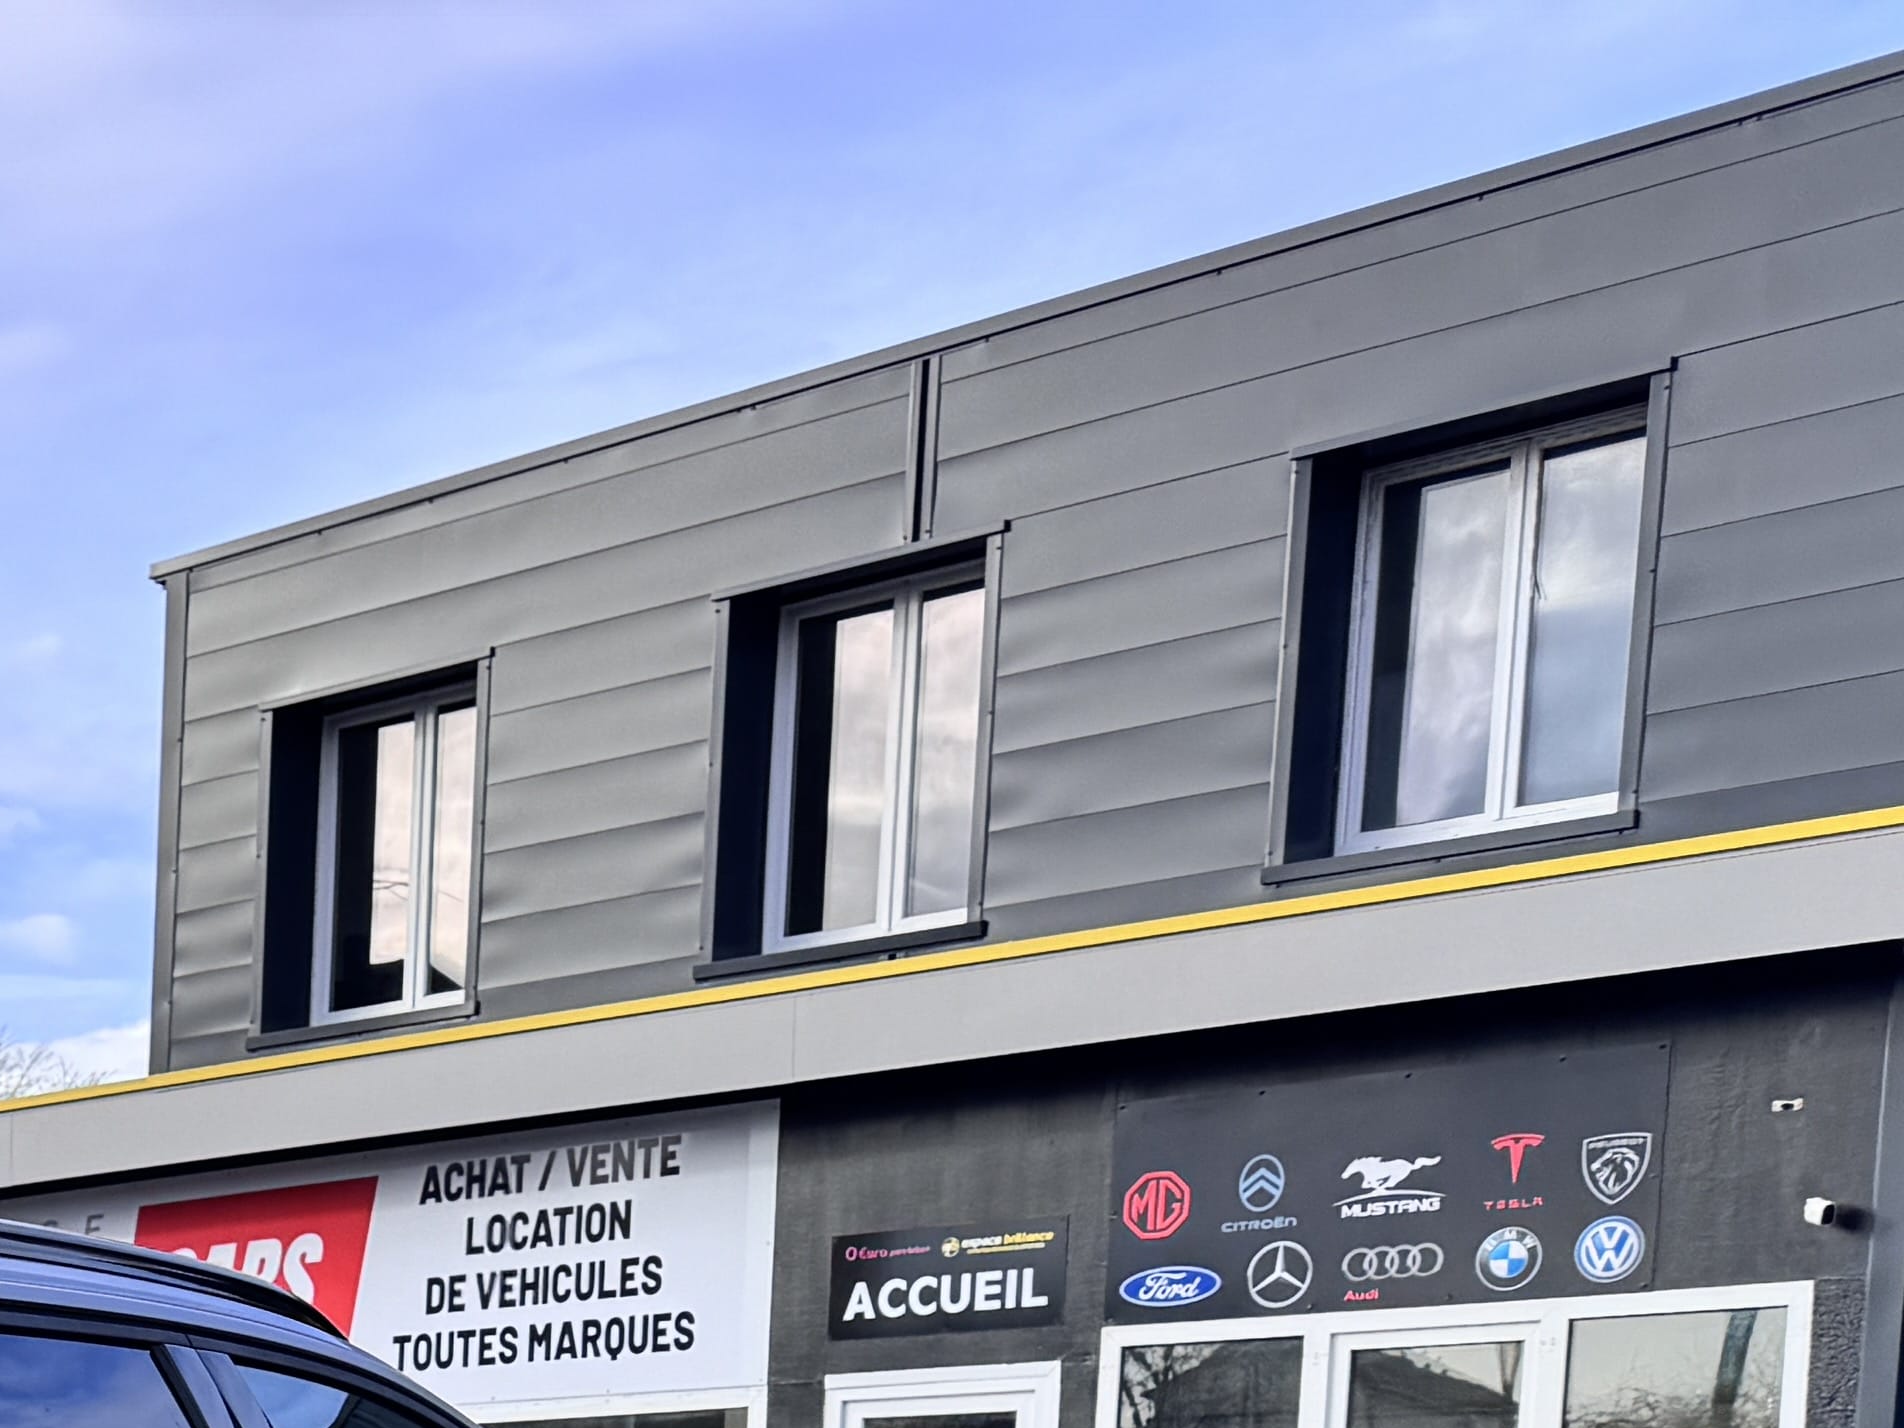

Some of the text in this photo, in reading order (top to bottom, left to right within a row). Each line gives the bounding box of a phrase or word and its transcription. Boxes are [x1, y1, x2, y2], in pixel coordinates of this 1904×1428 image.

[419, 1134, 681, 1206] ACHAT / VENTE
[464, 1199, 632, 1256] LOCATION
[1130, 1177, 1184, 1232] MG
[1340, 1196, 1441, 1219] MUSTANG
[1483, 1196, 1545, 1211] TESLA
[171, 1232, 324, 1305] RS
[425, 1256, 663, 1316] DE VEHICULES
[842, 1267, 1049, 1321] ACCUEIL
[1137, 1271, 1201, 1301] Ford
[1343, 1288, 1380, 1302] Audi
[393, 1310, 695, 1373] TOUTES MARQUES
